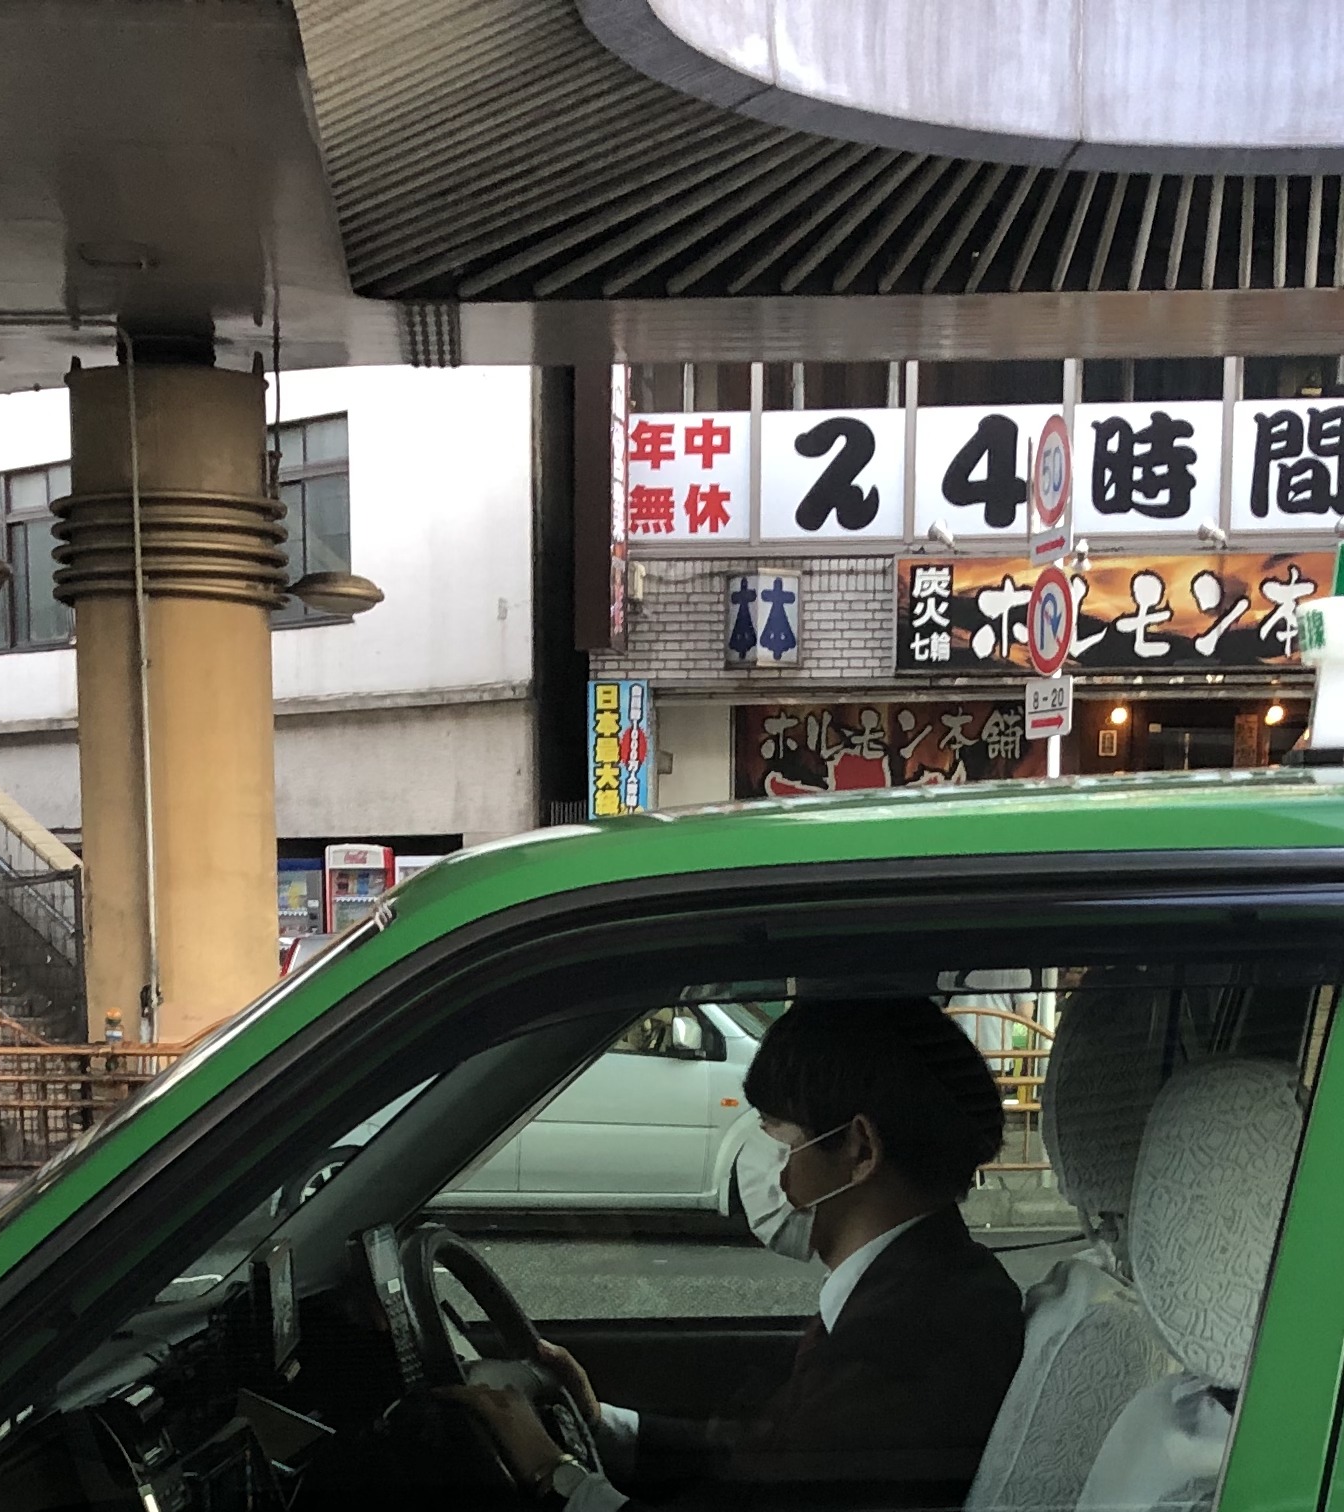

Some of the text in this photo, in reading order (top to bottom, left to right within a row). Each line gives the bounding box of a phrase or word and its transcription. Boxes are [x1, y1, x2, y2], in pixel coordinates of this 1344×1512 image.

[629, 418, 732, 470] 年中
[1042, 446, 1063, 496] 50
[628, 483, 732, 535] 無休
[971, 567, 1318, 660] ホルモン本
